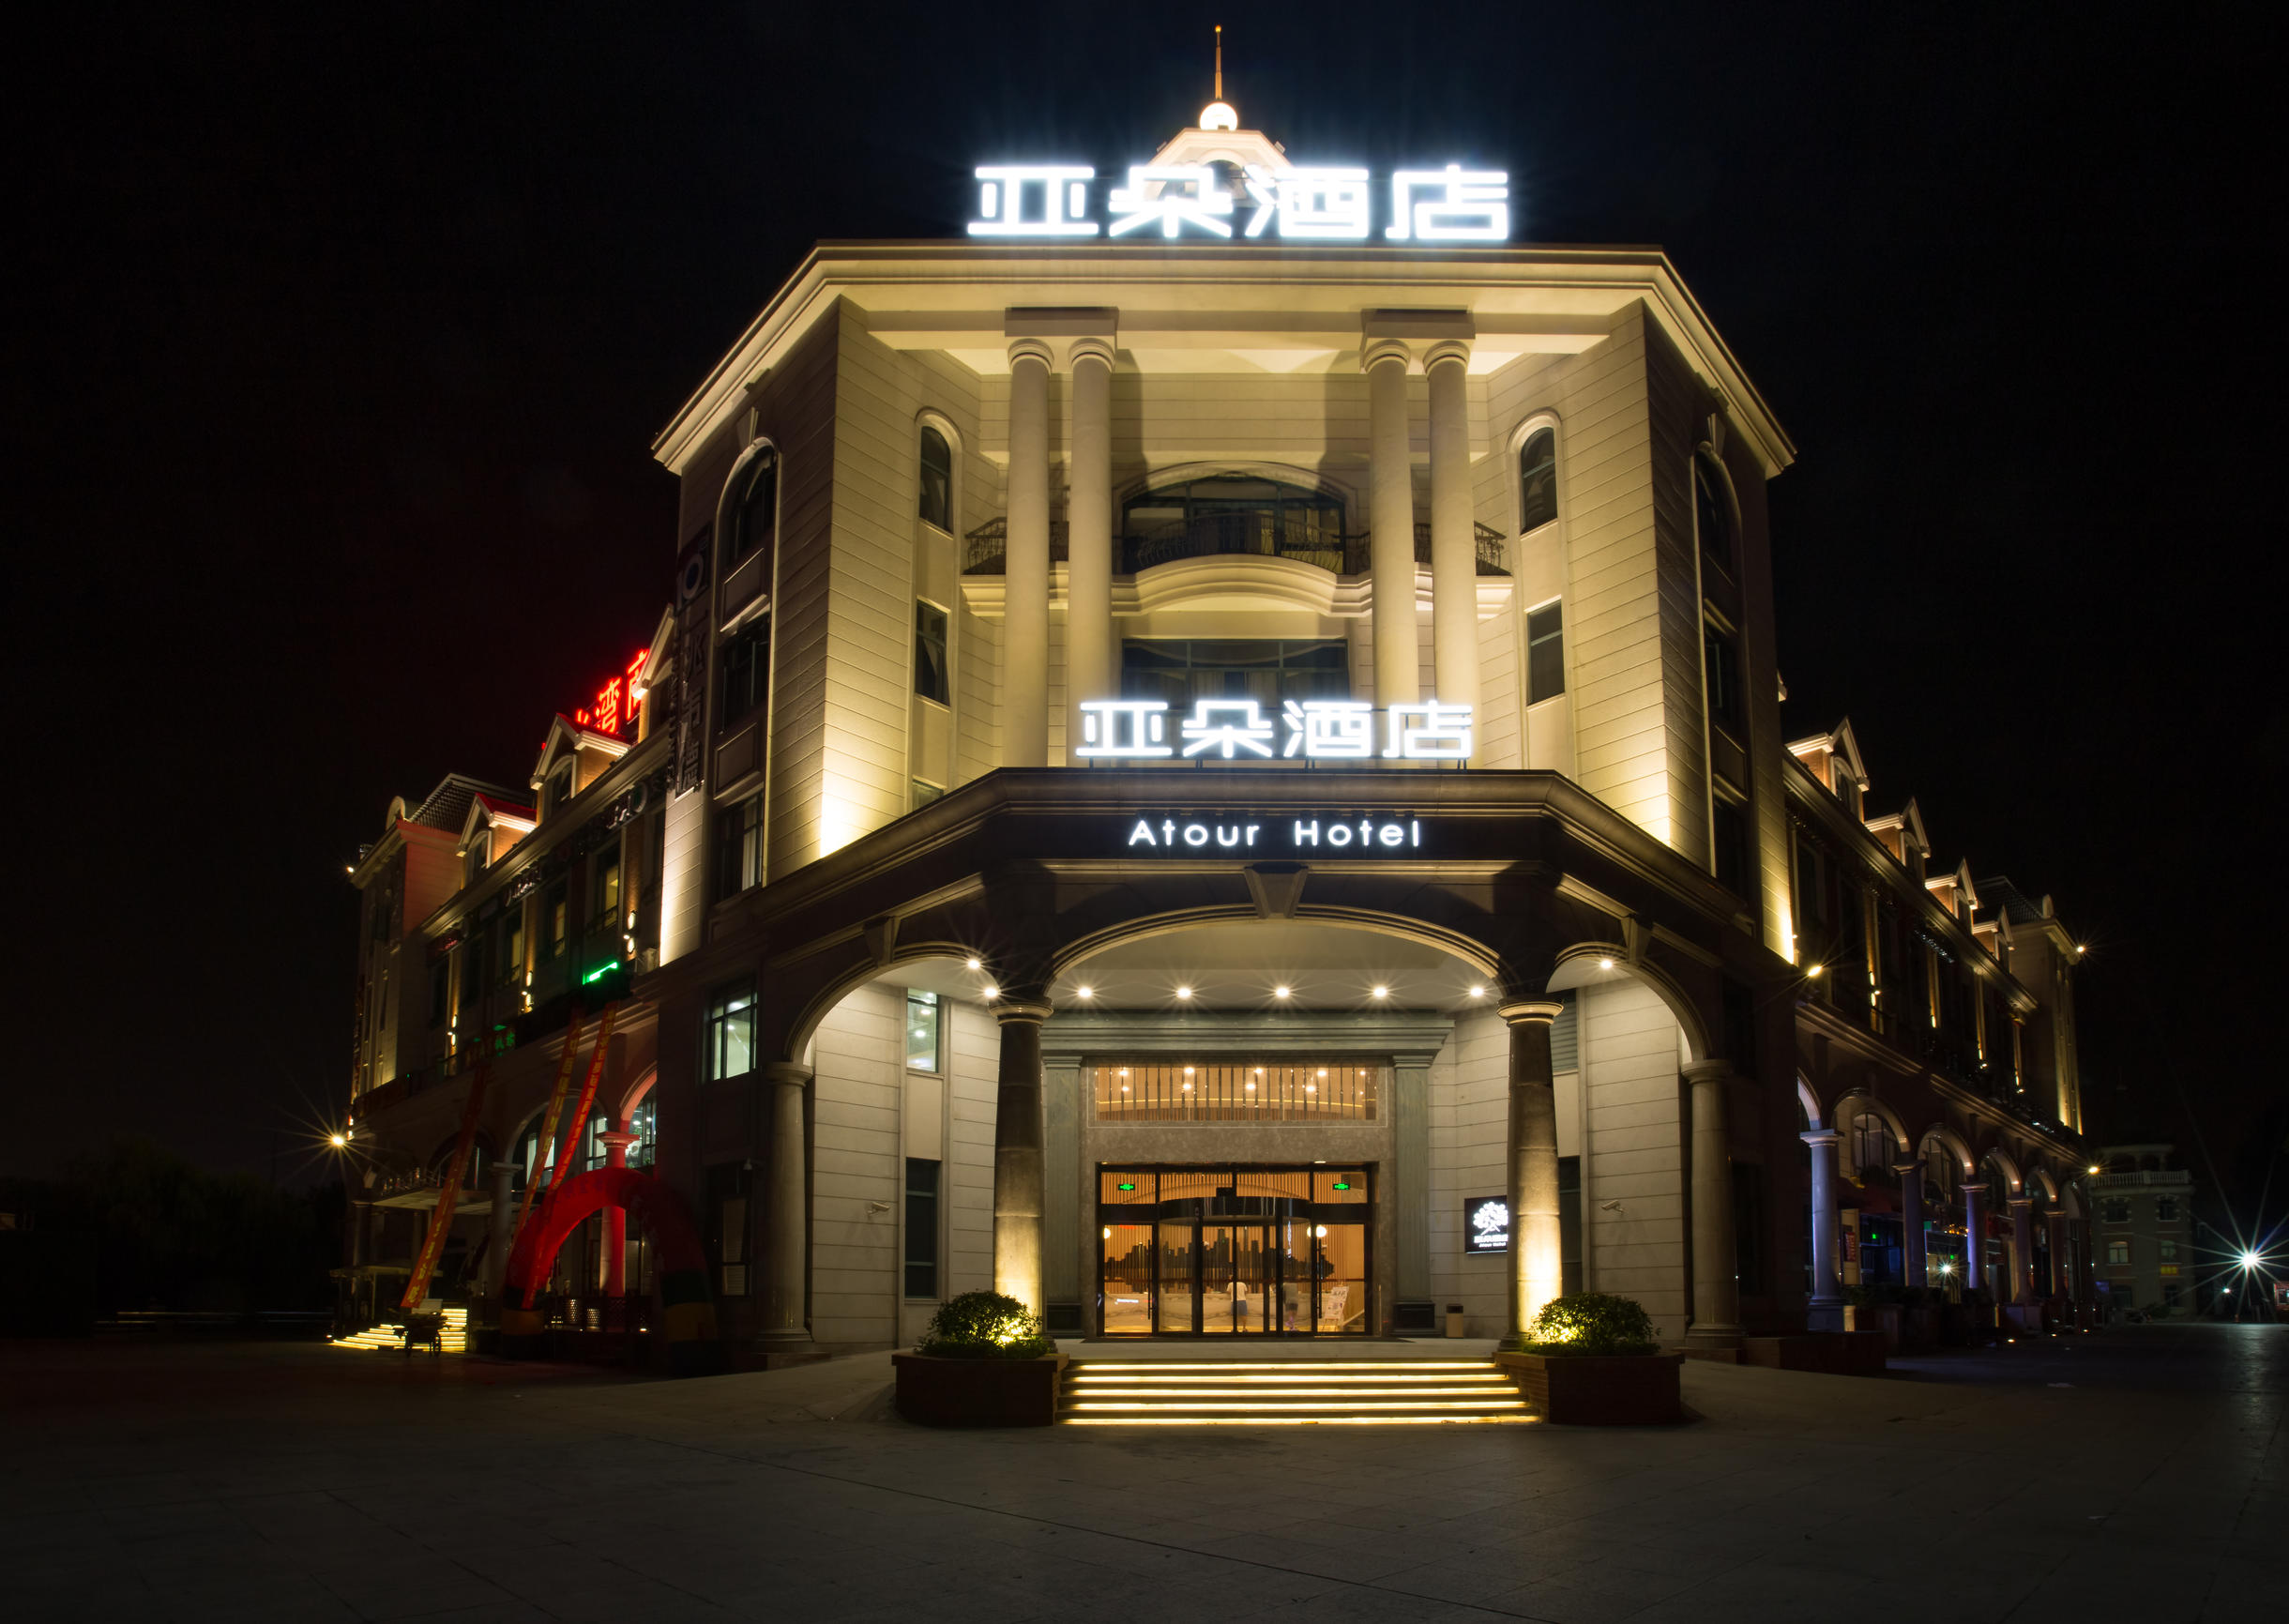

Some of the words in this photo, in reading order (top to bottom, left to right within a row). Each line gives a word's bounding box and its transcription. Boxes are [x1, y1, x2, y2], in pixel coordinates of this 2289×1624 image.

[967, 163, 1508, 240] 亚朵酒店
[1075, 699, 1474, 758] 亚朵酒店
[1128, 819, 1260, 846] Atour
[1294, 819, 1420, 847] Hotel
